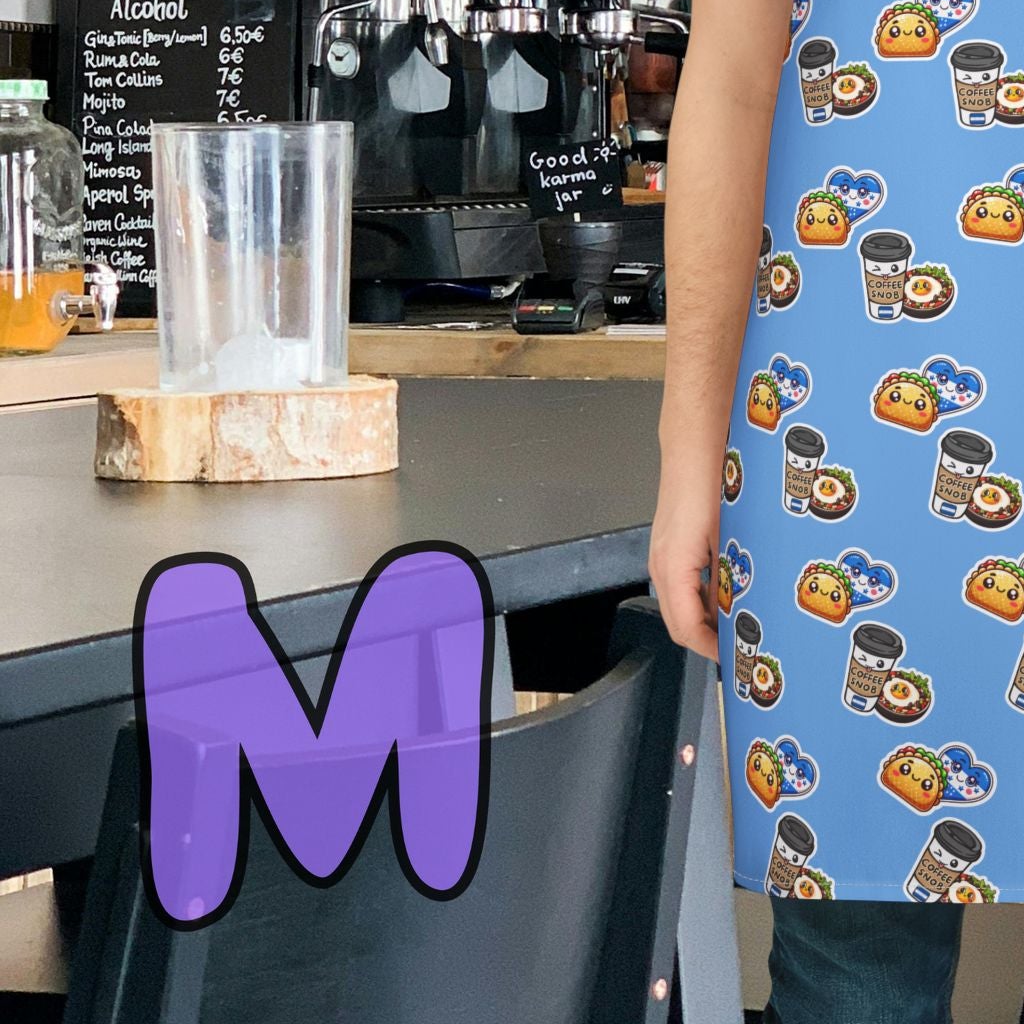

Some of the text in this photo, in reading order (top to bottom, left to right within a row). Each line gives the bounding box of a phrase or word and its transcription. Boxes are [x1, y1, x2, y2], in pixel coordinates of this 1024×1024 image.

[220, 26, 265, 45] 6,50€
[130, 51, 160, 68] Cola
[219, 47, 244, 64] 6€
[84, 67, 244, 88] Tom Collins 7€
[804, 83, 830, 94] COFFEE
[959, 88, 994, 97] COFFEE
[83, 89, 240, 115] Mojito 7€
[807, 95, 829, 103] SNOB
[963, 98, 991, 106] SNOB
[82, 137, 115, 162] Long
[529, 146, 588, 169] Good
[83, 160, 141, 180] Mimosa
[540, 170, 596, 188] karma
[83, 183, 129, 210] Aperol
[555, 189, 583, 212] jar
[118, 232, 148, 248] Wine
[110, 250, 146, 269] Coffee
[868, 279, 901, 289] COFFEE
[872, 291, 899, 299] SNOB
[787, 470, 811, 485] COFFEE
[939, 474, 972, 491] COFFEE
[790, 483, 808, 494] SNOB
[939, 486, 966, 500] SNOB
[850, 666, 883, 684] COFFEE
[850, 678, 876, 694] SNOB
[771, 867, 789, 887] SNOB
[772, 856, 795, 880] COFFEE
[921, 859, 952, 883] COFFEE
[918, 869, 943, 890] SNOB
